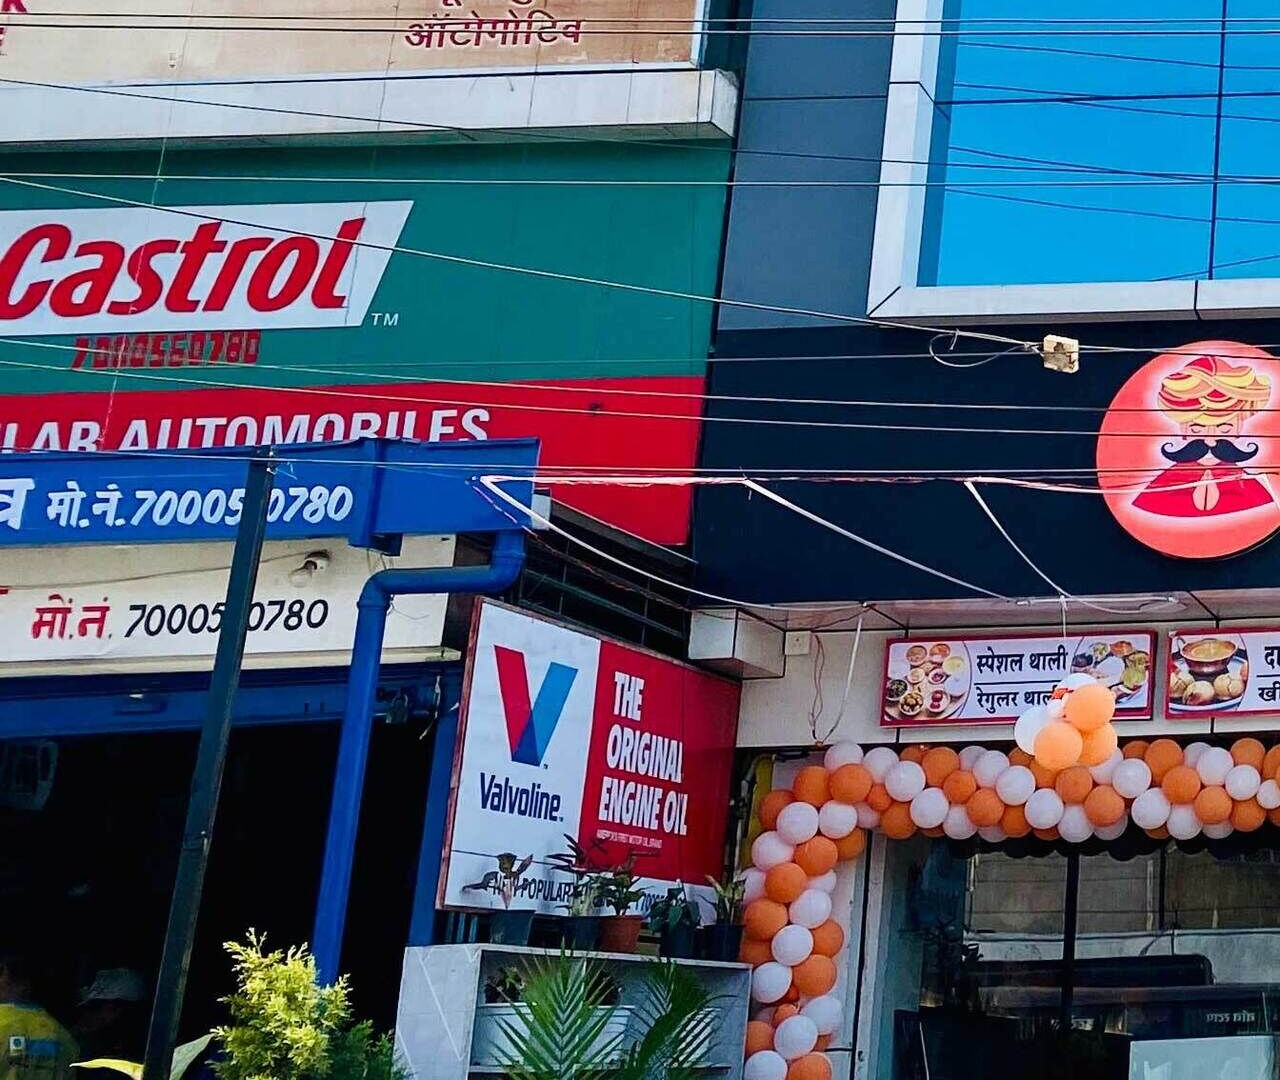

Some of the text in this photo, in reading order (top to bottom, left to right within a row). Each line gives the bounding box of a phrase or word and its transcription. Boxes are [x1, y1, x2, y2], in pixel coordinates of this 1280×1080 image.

[0, 217, 366, 320] Castrol
[124, 599, 329, 638] 700050780
[976, 645, 1068, 674] स्पेशल थाली
[613, 671, 644, 721] THE
[976, 687, 1019, 714] रेगुलर
[606, 723, 684, 783] ORIGINAL
[480, 772, 561, 823] Valvoline
[598, 775, 688, 837] ENGINE OIL
